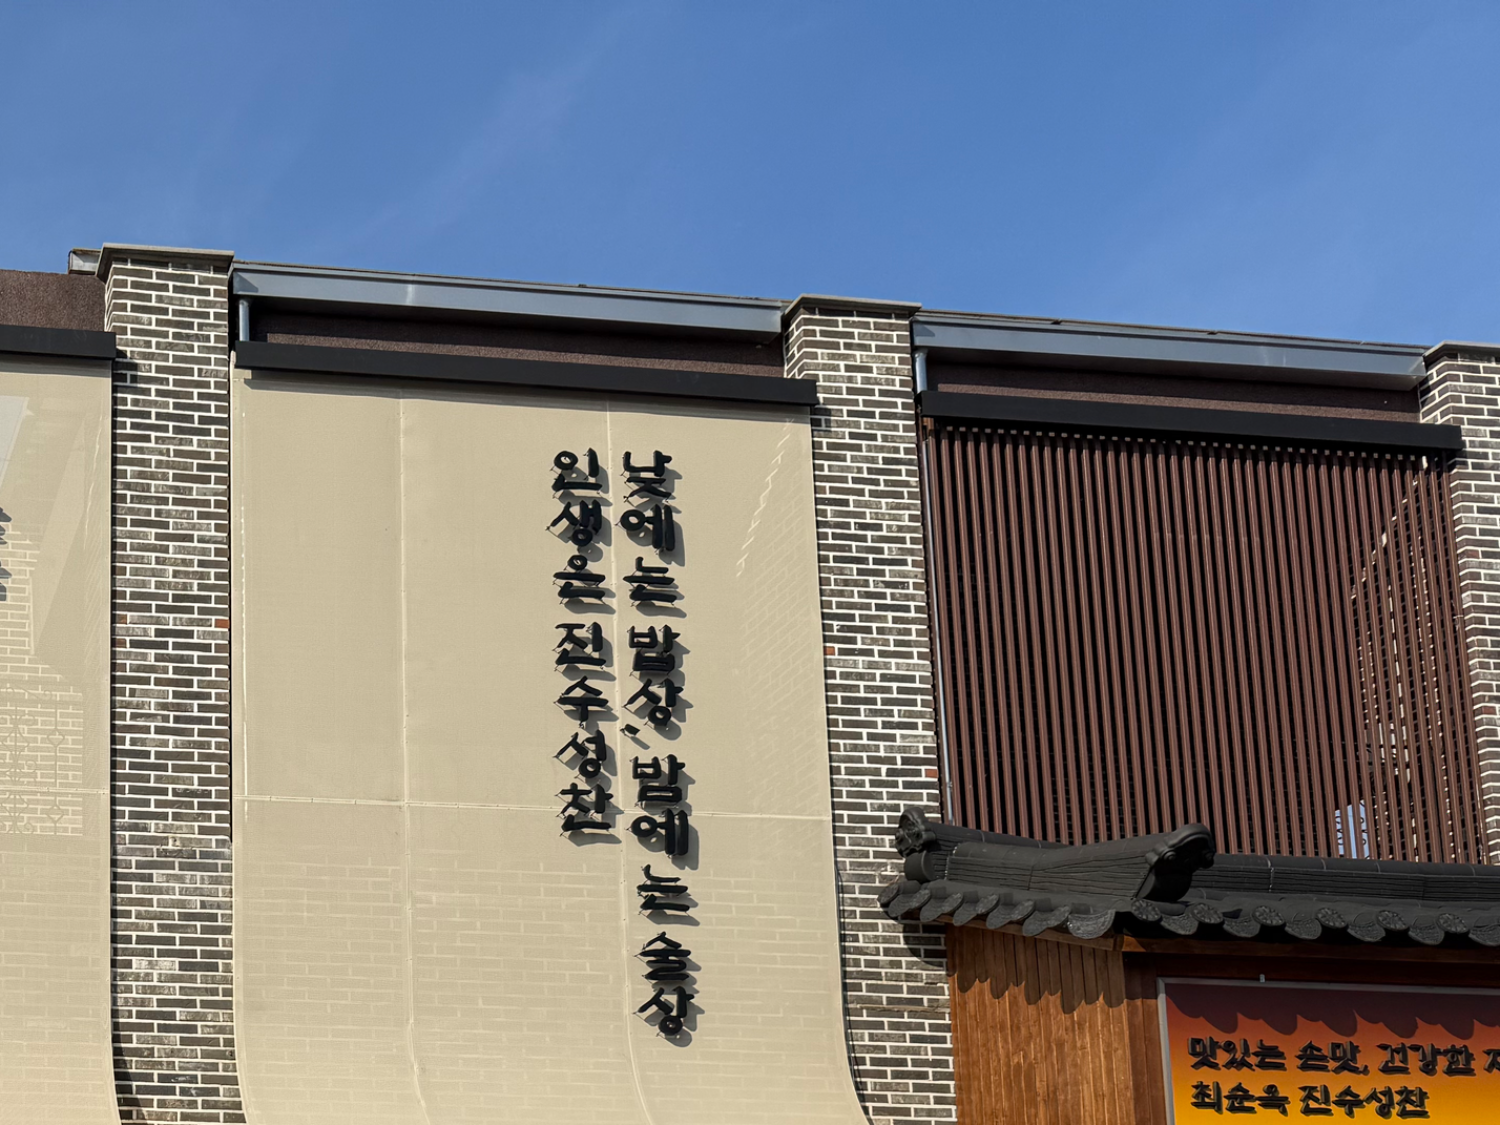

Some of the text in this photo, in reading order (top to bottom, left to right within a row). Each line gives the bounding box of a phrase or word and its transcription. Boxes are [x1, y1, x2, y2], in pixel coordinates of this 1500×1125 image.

[549, 447, 614, 832] 인생은 진수성찬
[619, 450, 695, 1036] 낮에는 밥상, 밤에는 술상
[1188, 1036, 1287, 1071] 맛있는
[1376, 1042, 1477, 1077] 건강한
[1191, 1081, 1431, 1120] 최순옥 진수성찬
